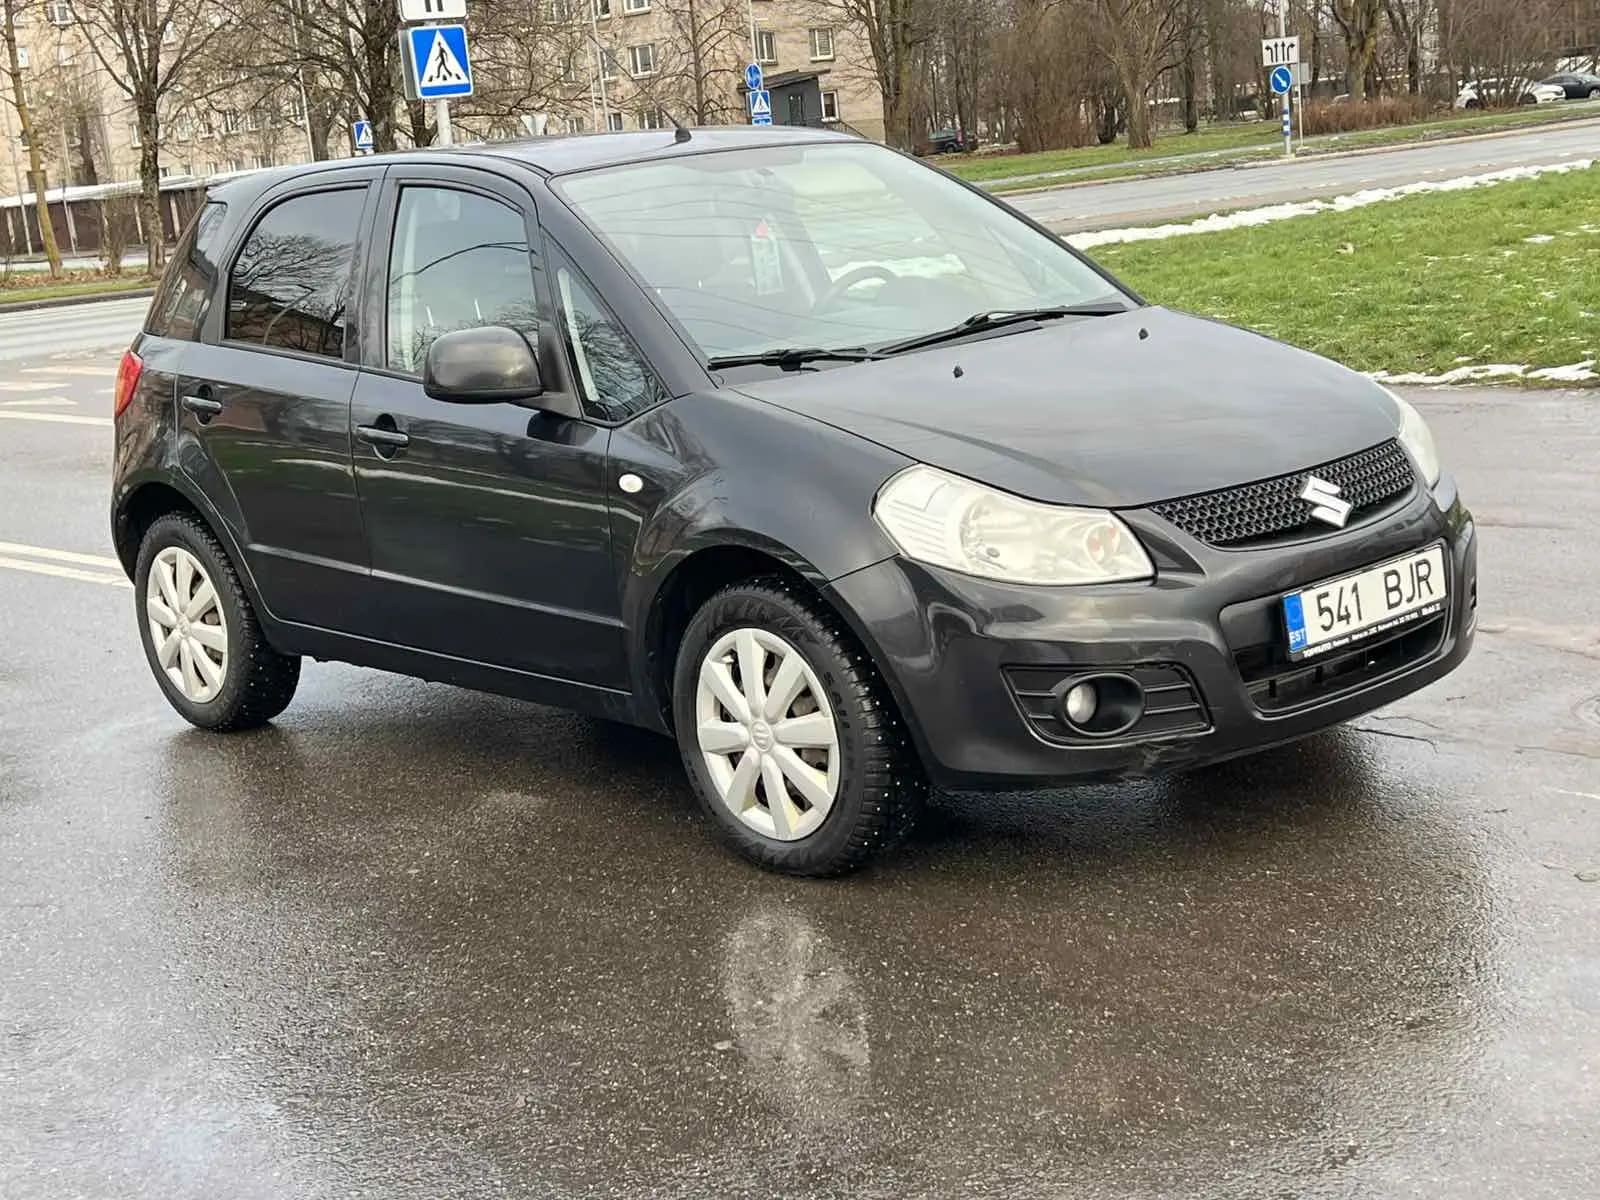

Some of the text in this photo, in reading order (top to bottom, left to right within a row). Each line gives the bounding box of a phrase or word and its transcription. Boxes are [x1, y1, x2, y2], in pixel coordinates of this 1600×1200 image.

[1316, 582, 1363, 632] 541
[1384, 559, 1433, 610] BJR
[1289, 629, 1305, 643] EST
